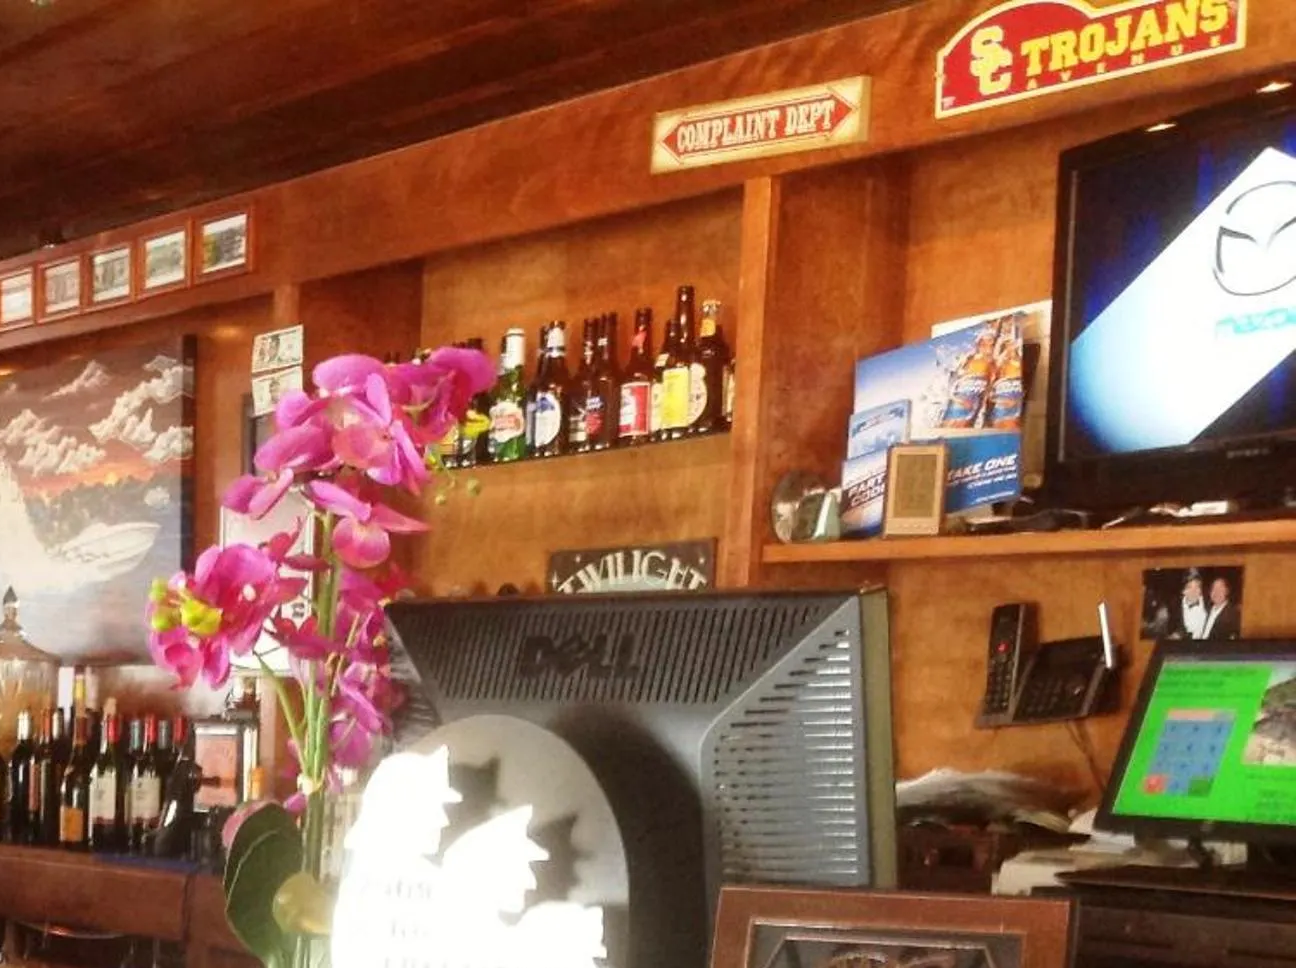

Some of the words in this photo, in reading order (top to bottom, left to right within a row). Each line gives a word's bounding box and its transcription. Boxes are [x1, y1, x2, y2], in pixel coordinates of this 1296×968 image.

[1021, 0, 1229, 76] TROJANS
[1026, 35, 1221, 91] AVENUE
[677, 110, 781, 152] COMPLAINT
[785, 100, 836, 134] DEPT
[557, 550, 707, 594] TWILIGHT
